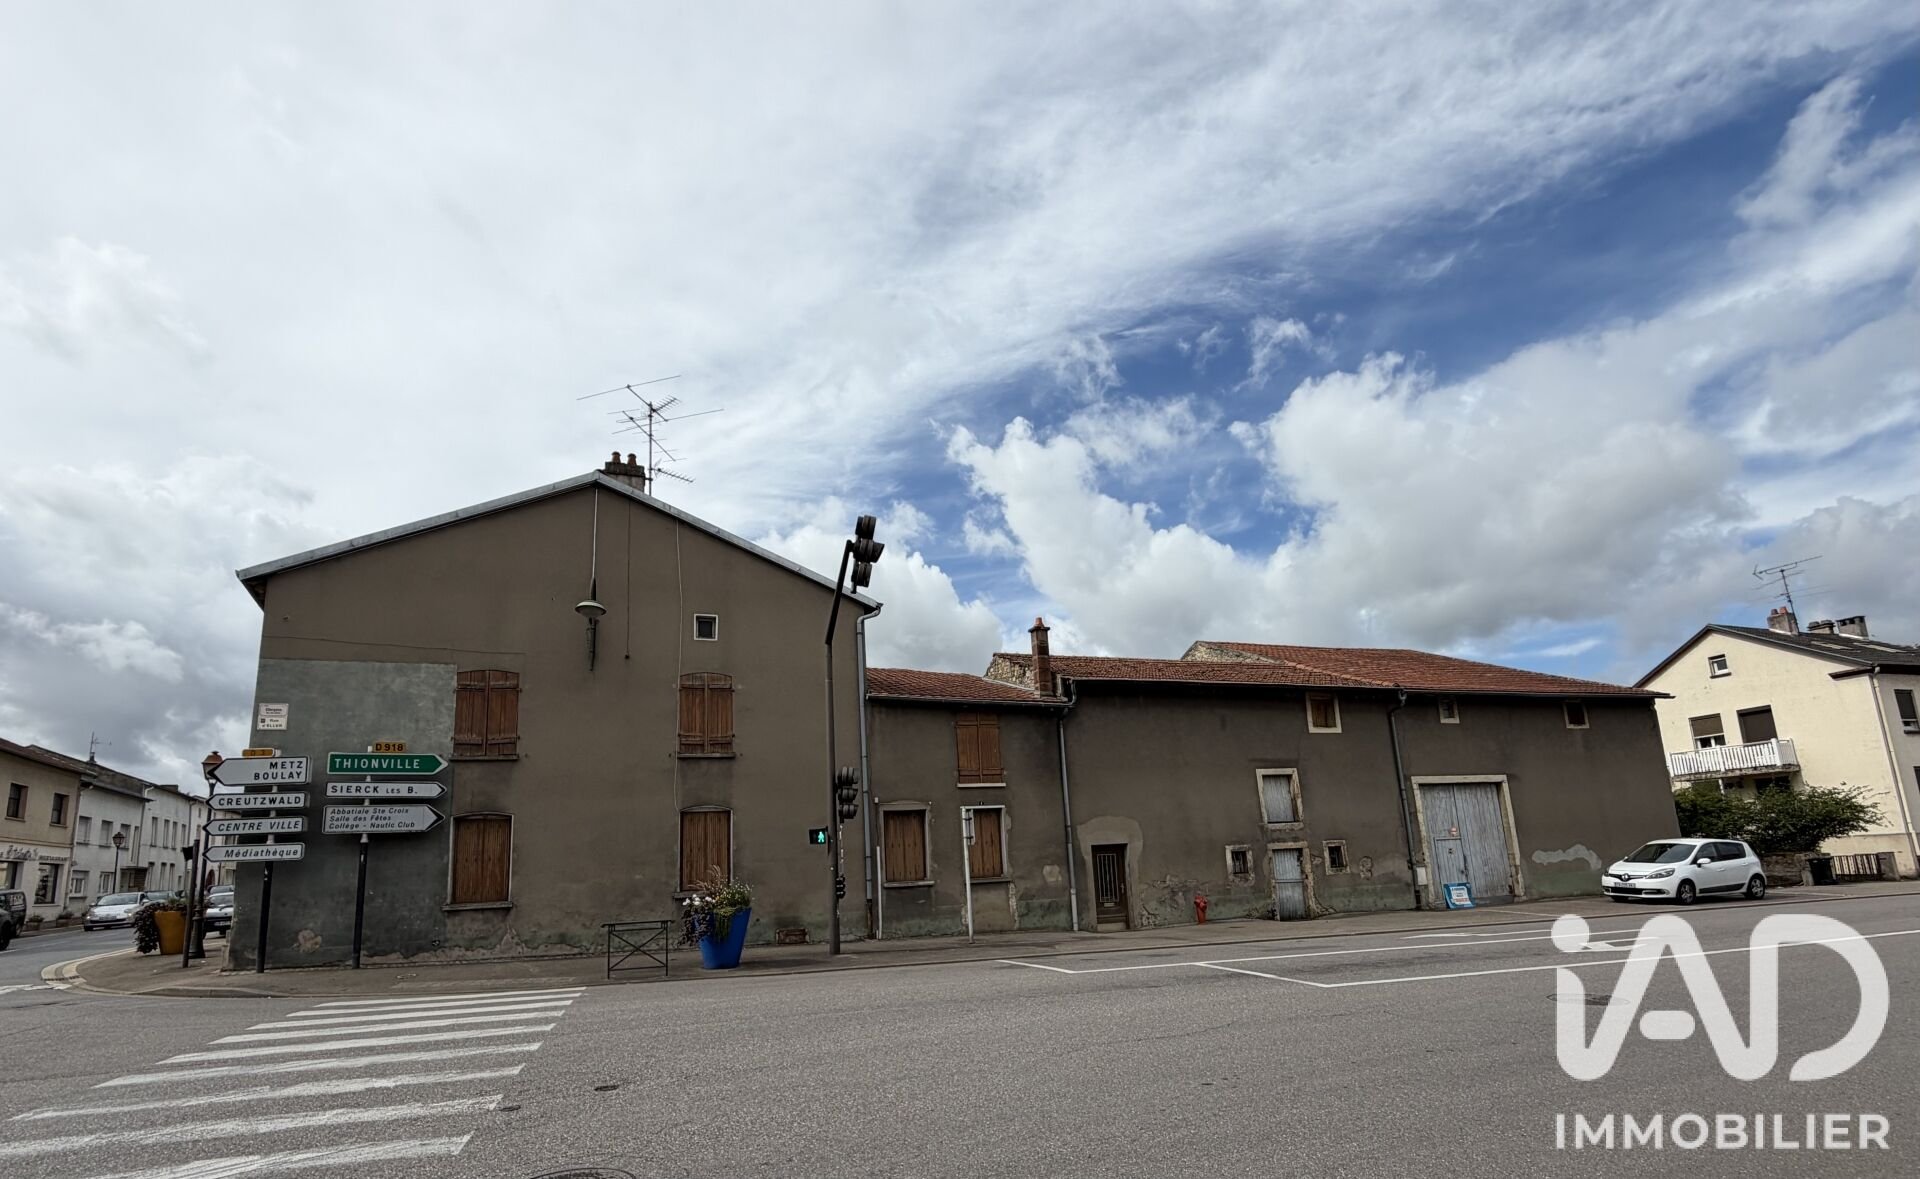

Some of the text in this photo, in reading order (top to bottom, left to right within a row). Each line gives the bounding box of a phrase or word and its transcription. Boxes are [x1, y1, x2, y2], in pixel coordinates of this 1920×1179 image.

[384, 744, 404, 752] 918
[270, 760, 303, 770] METZ
[334, 758, 420, 768] THIONVILLE
[254, 770, 302, 780] BOULAY
[330, 785, 380, 794] SIERCK
[408, 786, 418, 794] B.
[218, 796, 300, 806] CREUTZWALD
[218, 820, 300, 832] CENTRE VILLE
[224, 848, 298, 858] Médiathèque
